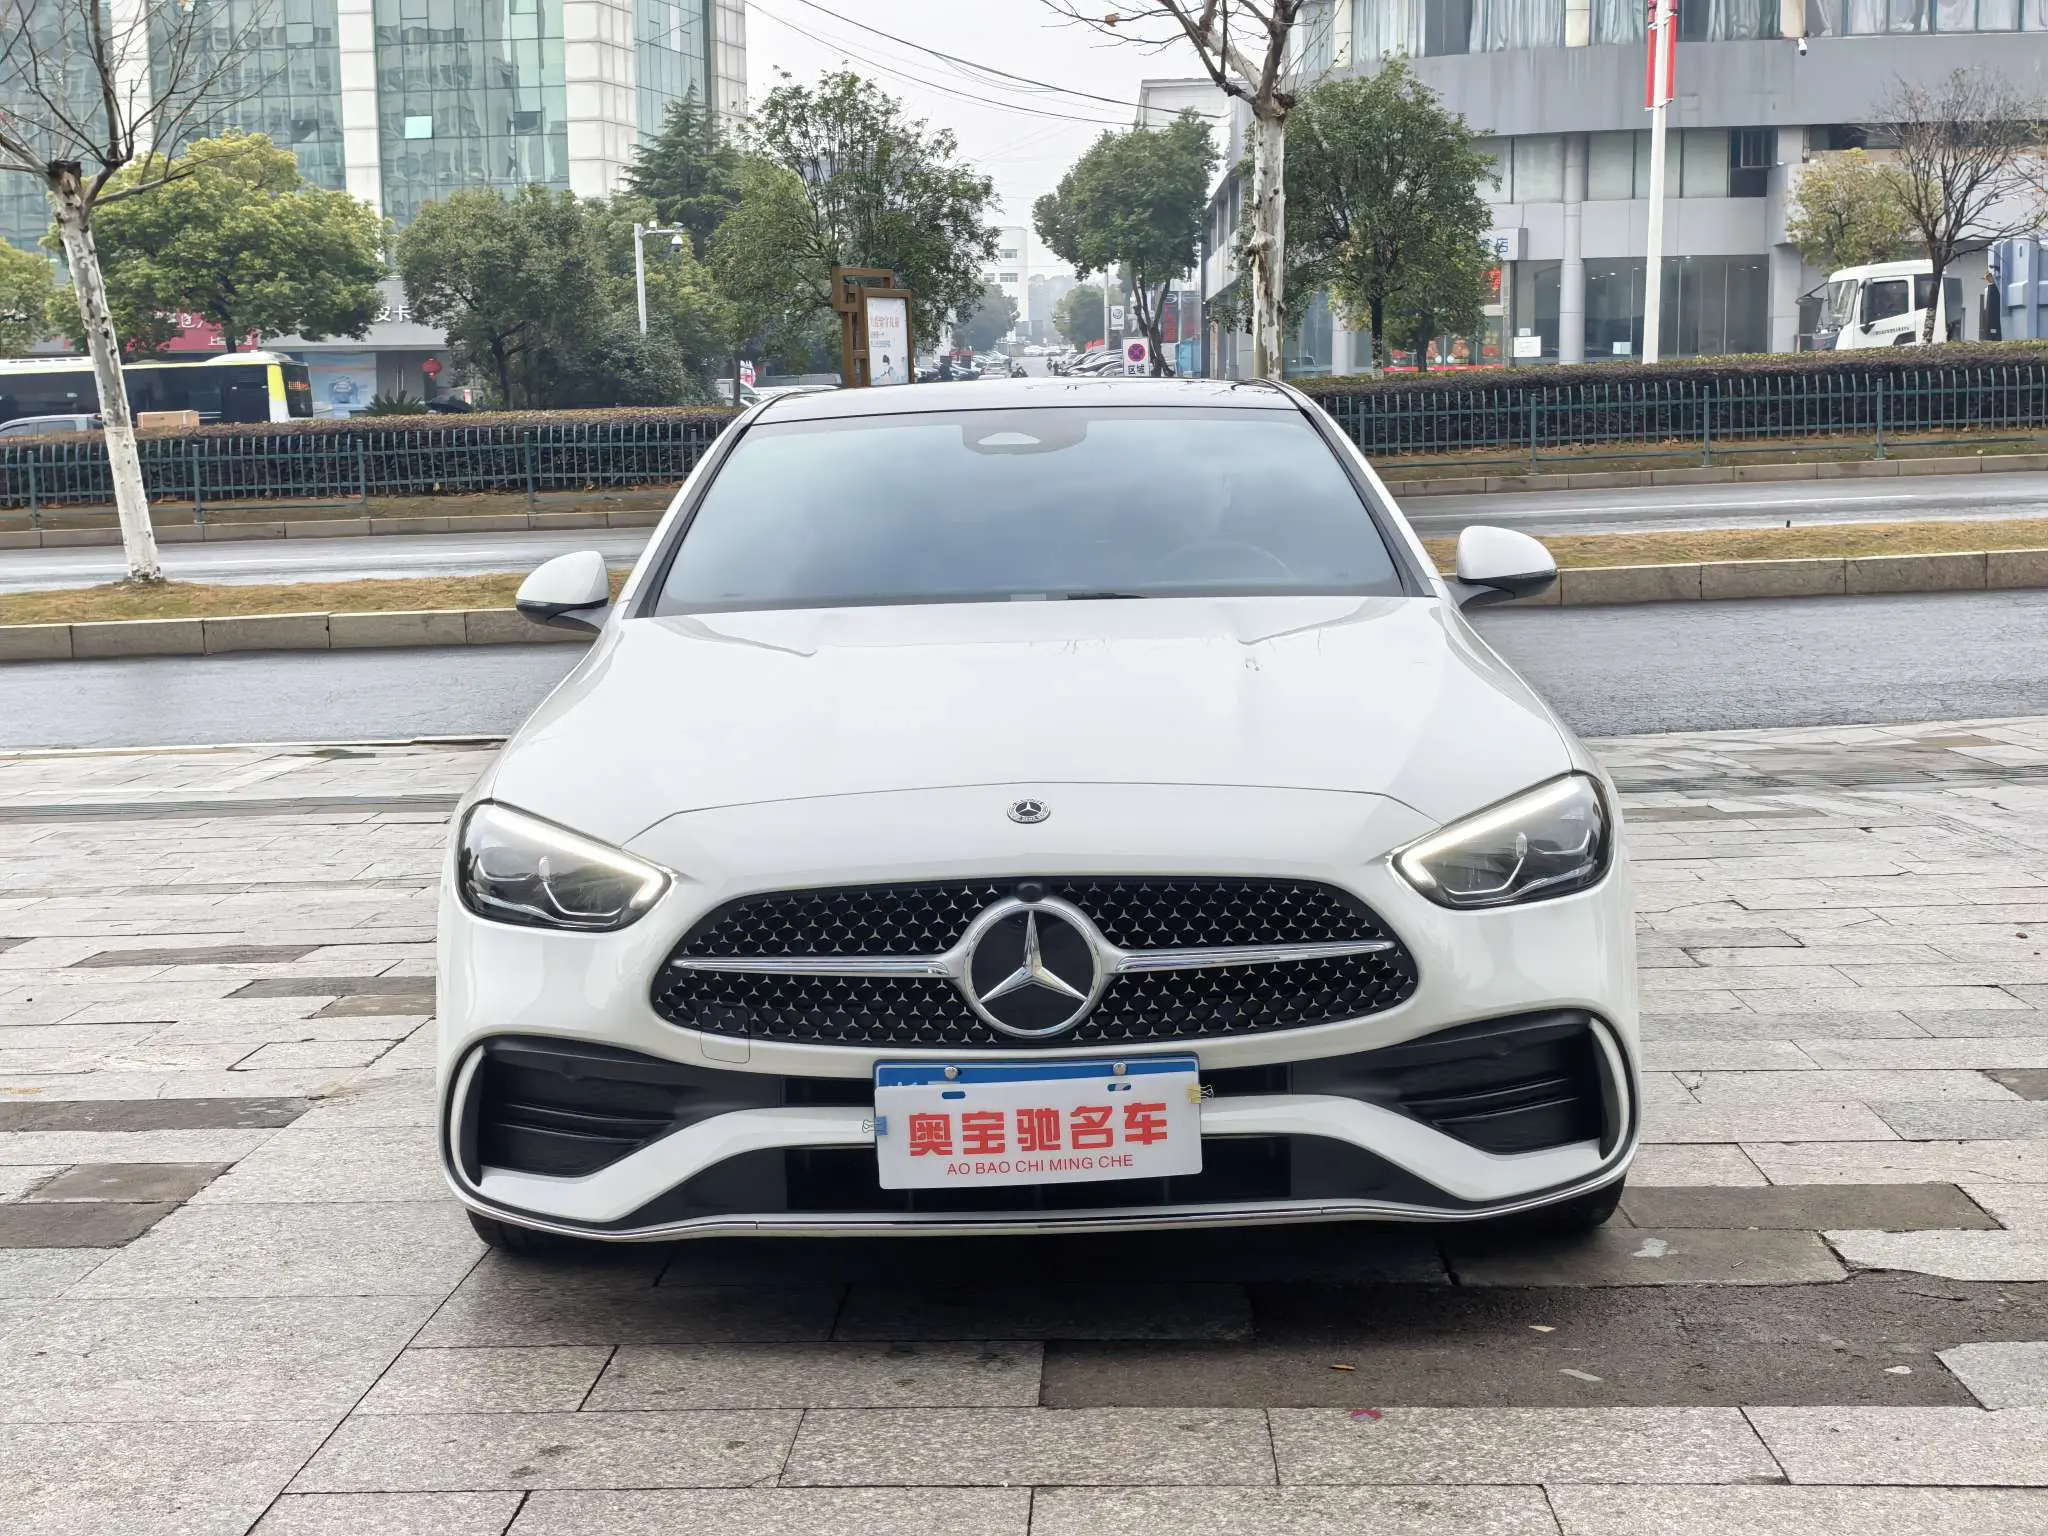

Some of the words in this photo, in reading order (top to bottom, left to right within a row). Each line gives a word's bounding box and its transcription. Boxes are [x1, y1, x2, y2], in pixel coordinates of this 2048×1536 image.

[908, 1102, 1168, 1157] 奥宝驰名车
[947, 1162, 970, 1175] AO
[975, 1161, 1010, 1174] BAO
[1015, 1159, 1044, 1173] CHI
[1049, 1156, 1093, 1172] MING
[1099, 1154, 1134, 1168] CHE
